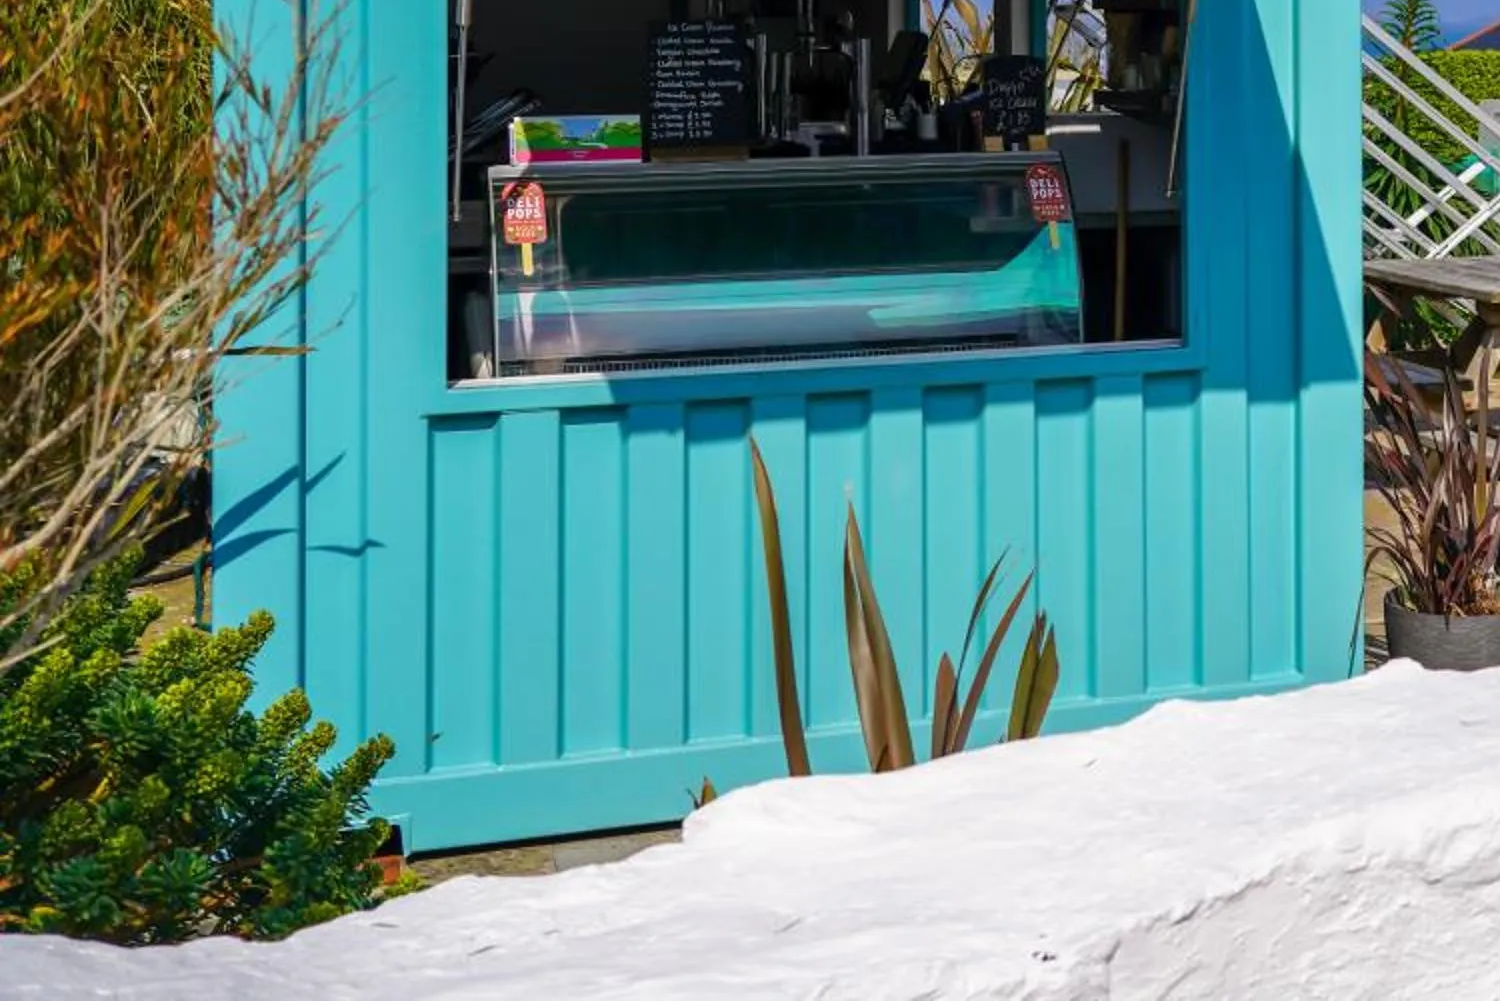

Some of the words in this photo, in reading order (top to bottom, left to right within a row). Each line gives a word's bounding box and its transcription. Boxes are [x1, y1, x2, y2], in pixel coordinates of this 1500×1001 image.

[1030, 178, 1059, 188] DELI
[1031, 188, 1062, 199] POPS
[507, 195, 540, 208] DELI
[507, 208, 541, 219] POPS
